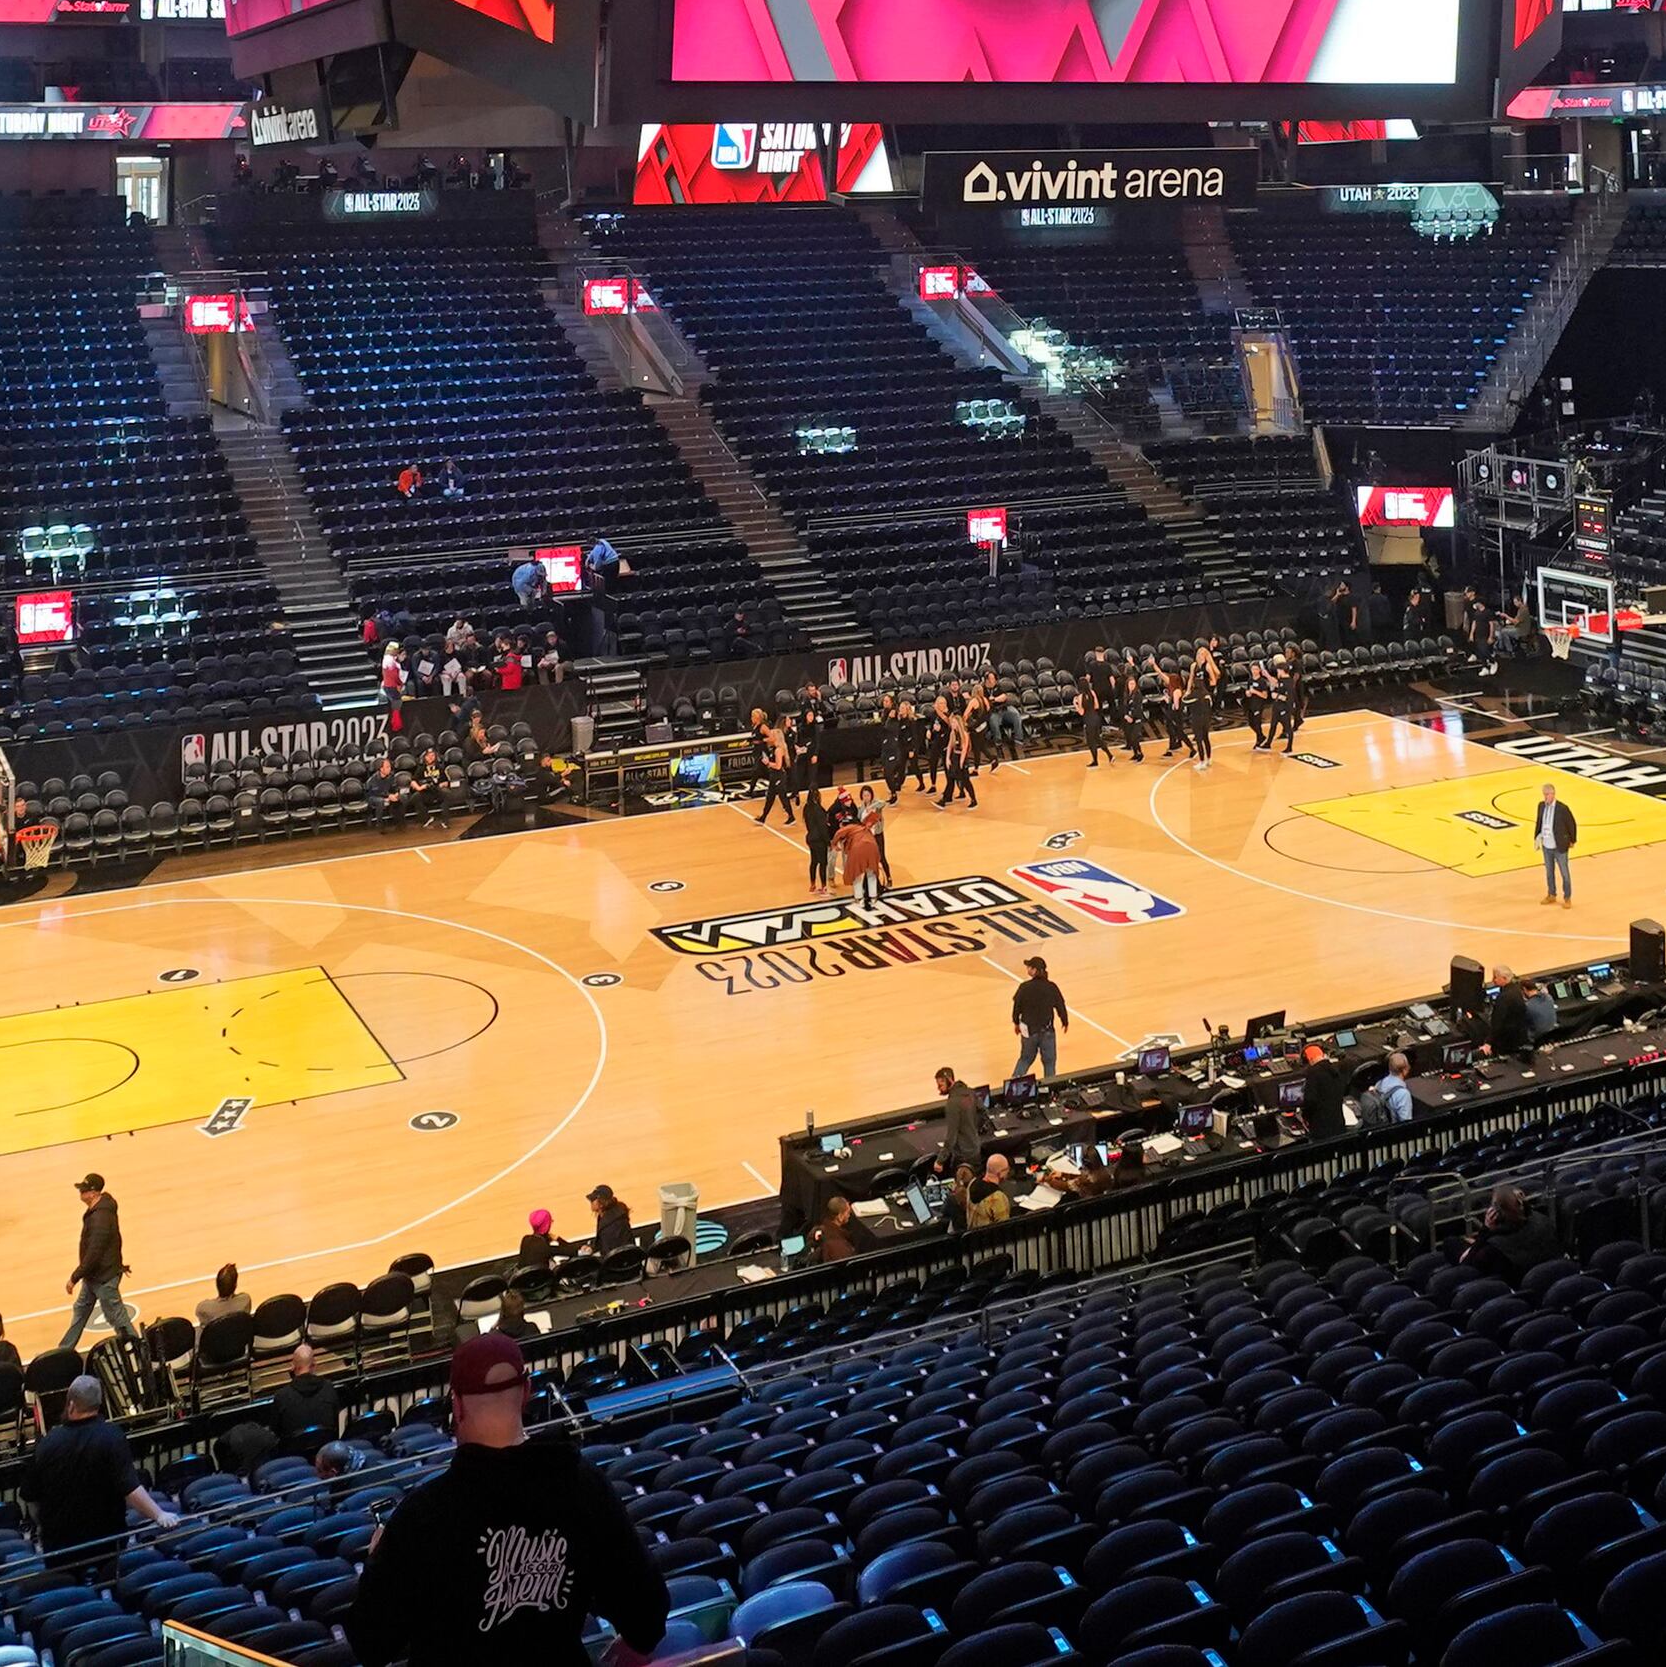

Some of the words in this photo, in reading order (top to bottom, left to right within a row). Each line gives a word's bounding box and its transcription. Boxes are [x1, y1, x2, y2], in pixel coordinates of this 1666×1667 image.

[47, 112, 86, 134] NIGHT
[1005, 159, 1118, 201] vivint
[1124, 167, 1224, 199] arena
[397, 192, 420, 211] 2023
[1340, 186, 1373, 203] UTAH
[1387, 186, 1419, 202] 2023
[486, 1524, 568, 1585] Music
